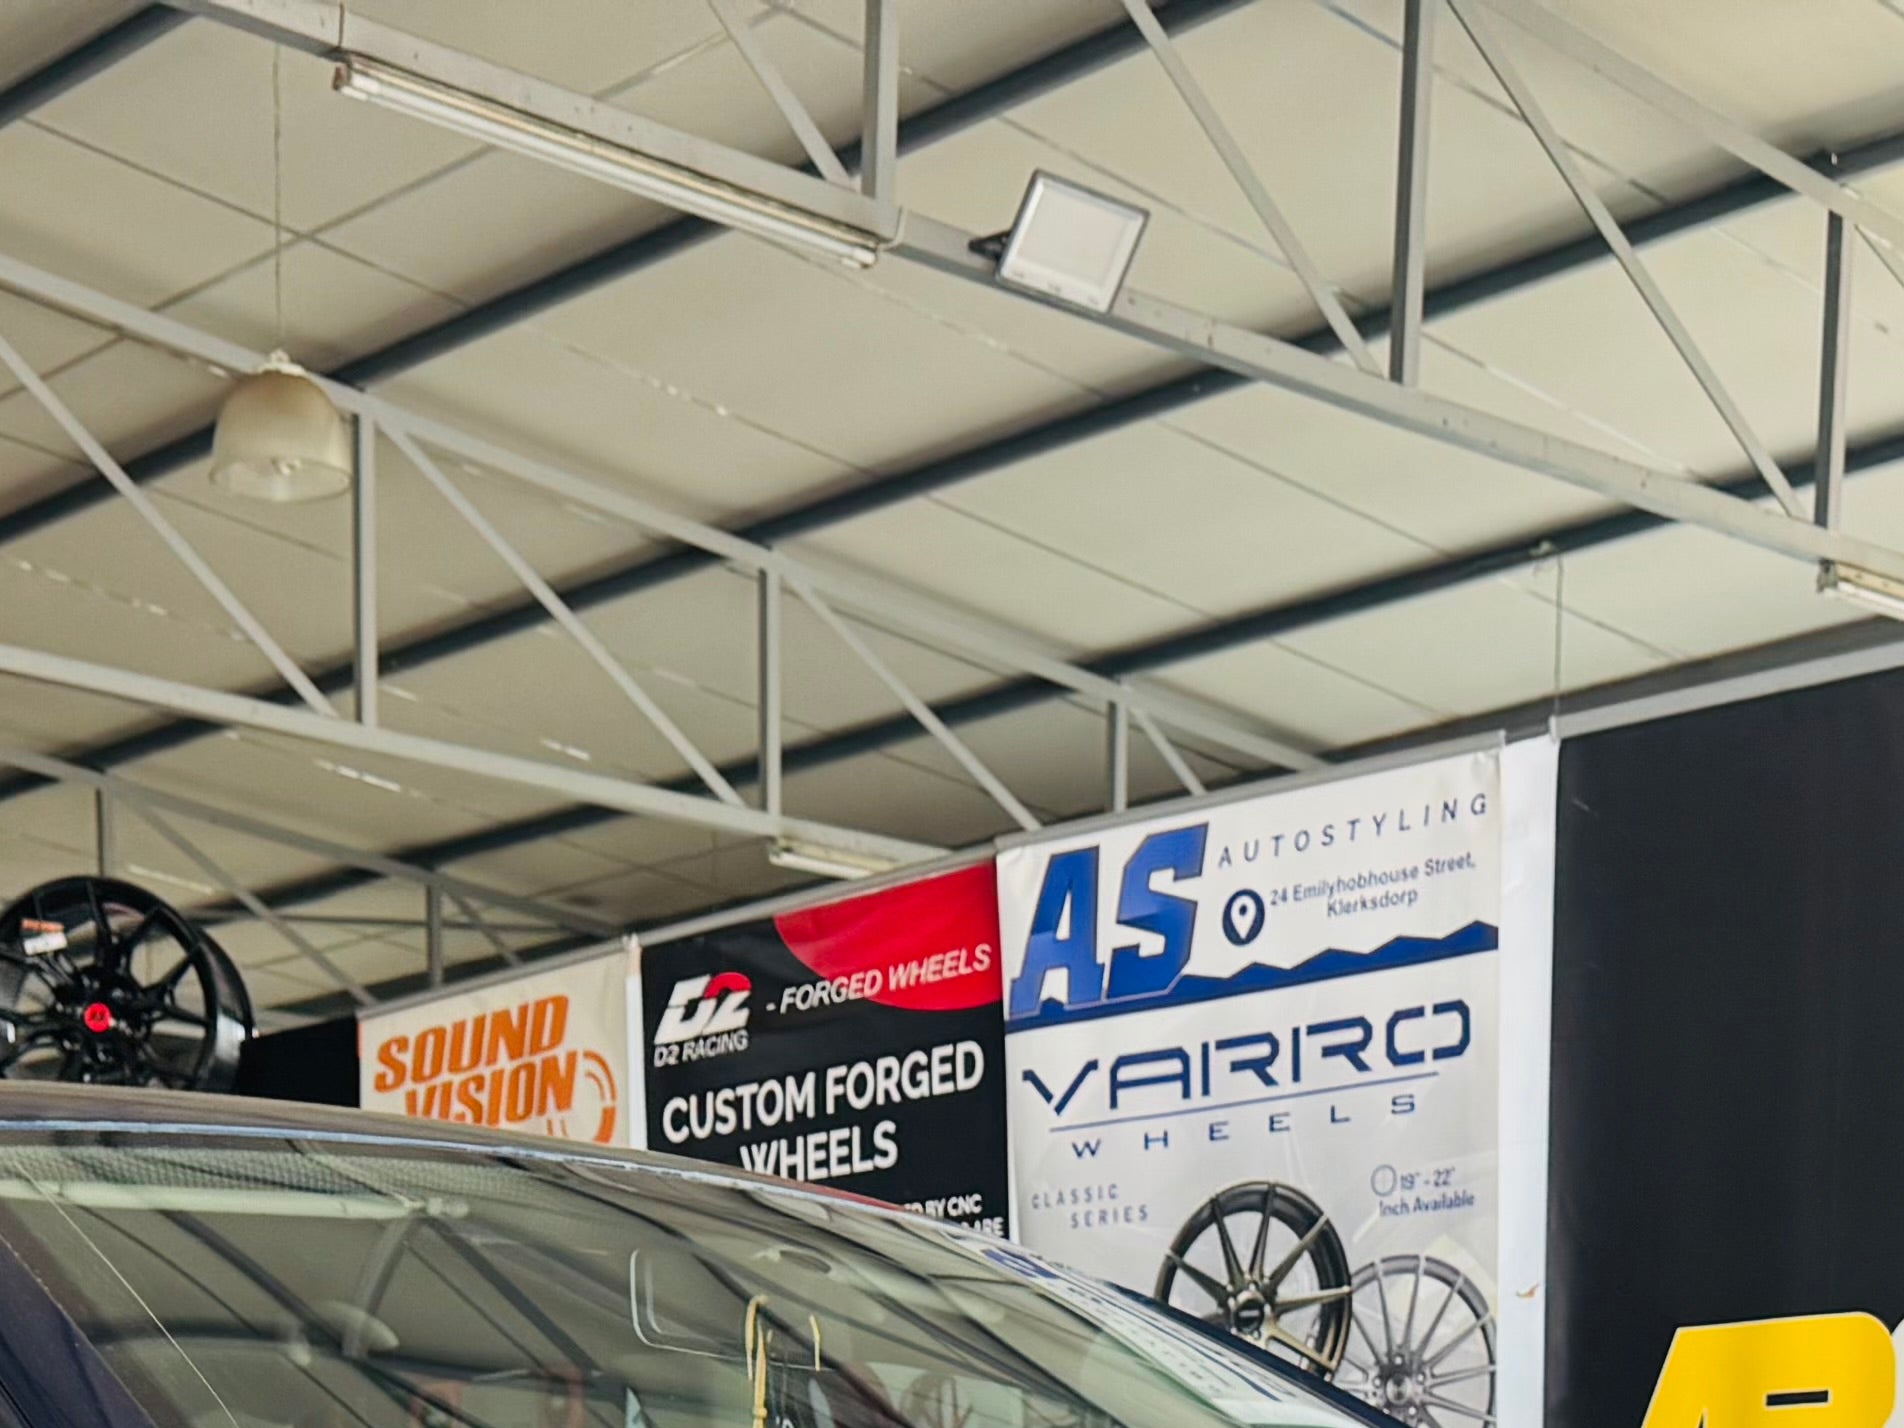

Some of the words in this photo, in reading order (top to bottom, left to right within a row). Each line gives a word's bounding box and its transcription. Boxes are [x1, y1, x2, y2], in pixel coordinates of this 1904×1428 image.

[1218, 792, 1489, 868] AUTOSTYLING
[1270, 887, 1289, 906] 24
[1292, 864, 1421, 903] Emilyhobhouse
[1326, 886, 1419, 919] Klerksdorp
[1010, 822, 1210, 1019] AS
[780, 968, 883, 1014] FORGED
[887, 944, 991, 986] WHEELS
[374, 996, 569, 1091] SOUND
[653, 1047, 679, 1068] D2
[682, 1030, 748, 1062] RACING
[663, 1071, 824, 1144] CUSTOM
[832, 1040, 985, 1104] FORGED
[739, 1122, 898, 1181] WHEELS
[1072, 1094, 1417, 1160] WHEELS
[947, 1194, 983, 1216] CNC
[1031, 1184, 1119, 1210] CLASSIC
[1070, 1204, 1150, 1228] SERIES
[1378, 1199, 1410, 1217] Inch
[1412, 1191, 1475, 1216] Available
